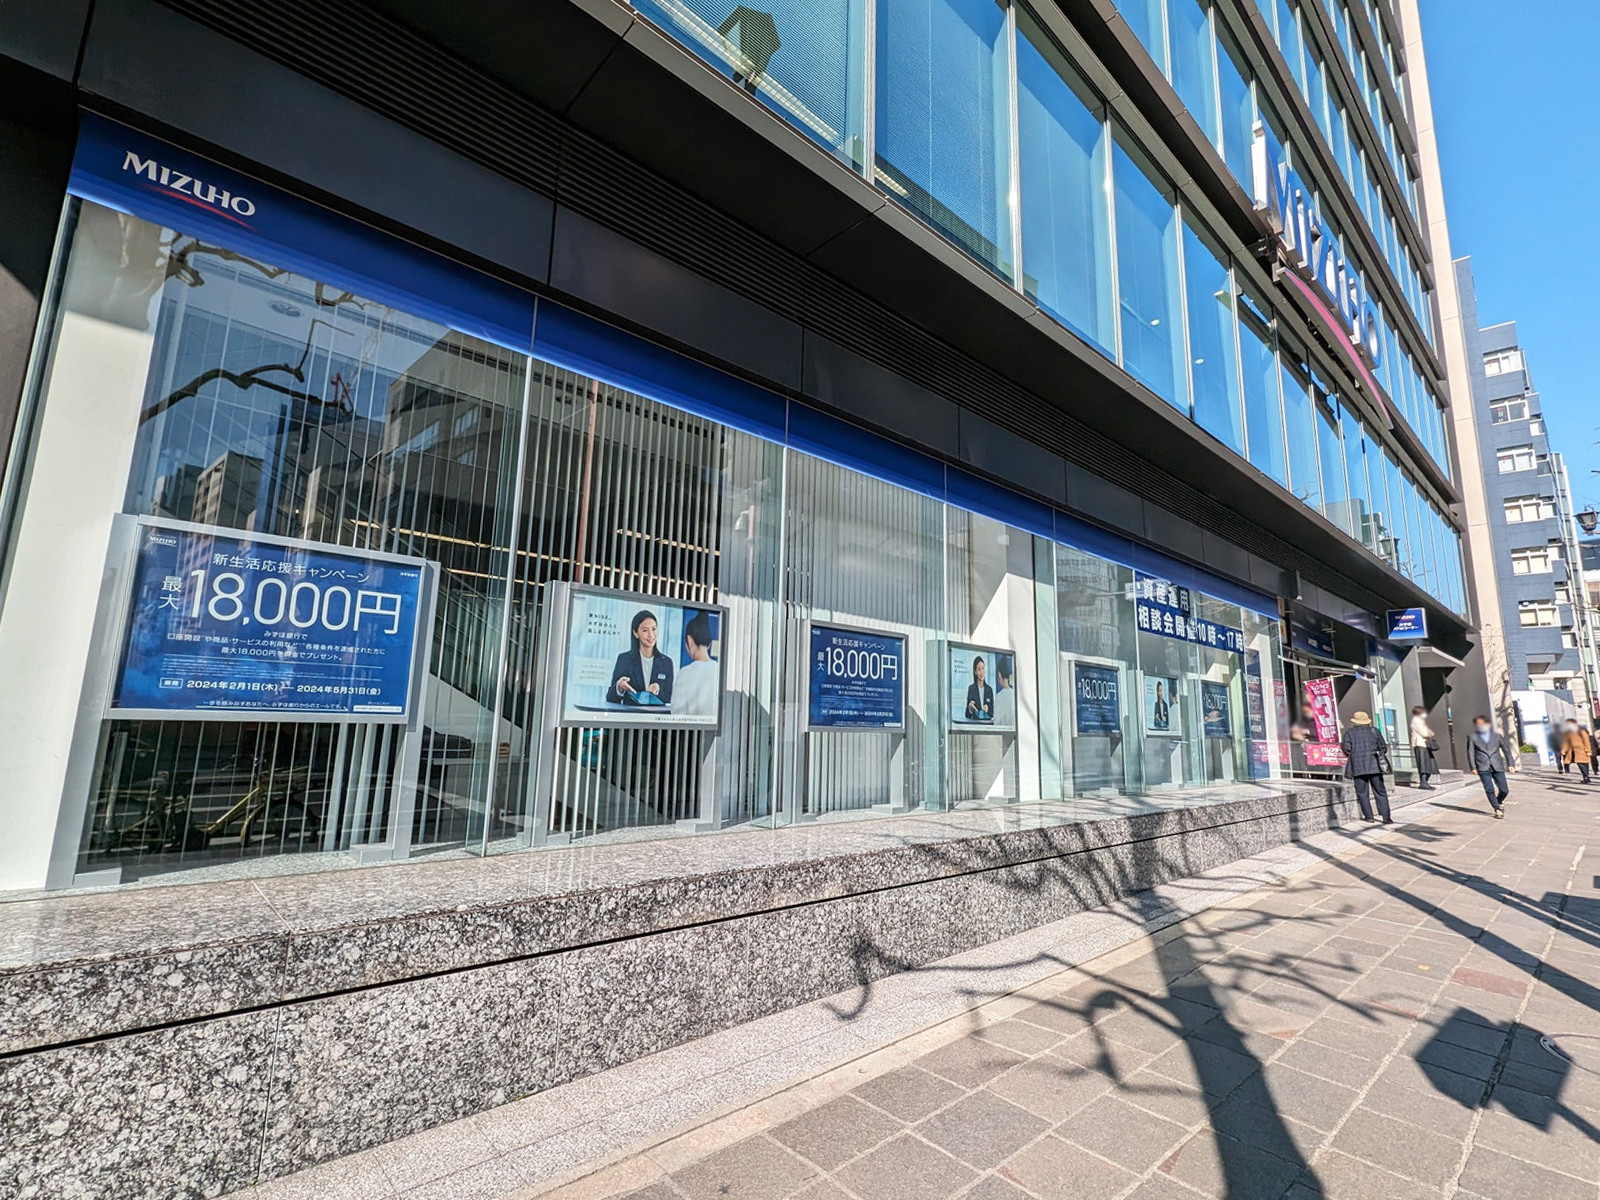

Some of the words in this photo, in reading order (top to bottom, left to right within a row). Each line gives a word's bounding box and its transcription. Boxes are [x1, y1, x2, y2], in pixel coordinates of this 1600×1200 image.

[122, 150, 256, 216] MIZUHO
[213, 552, 370, 584] 新生活応援キャンペーン
[191, 569, 402, 635] 18,000円
[825, 646, 898, 681] 18,000円
